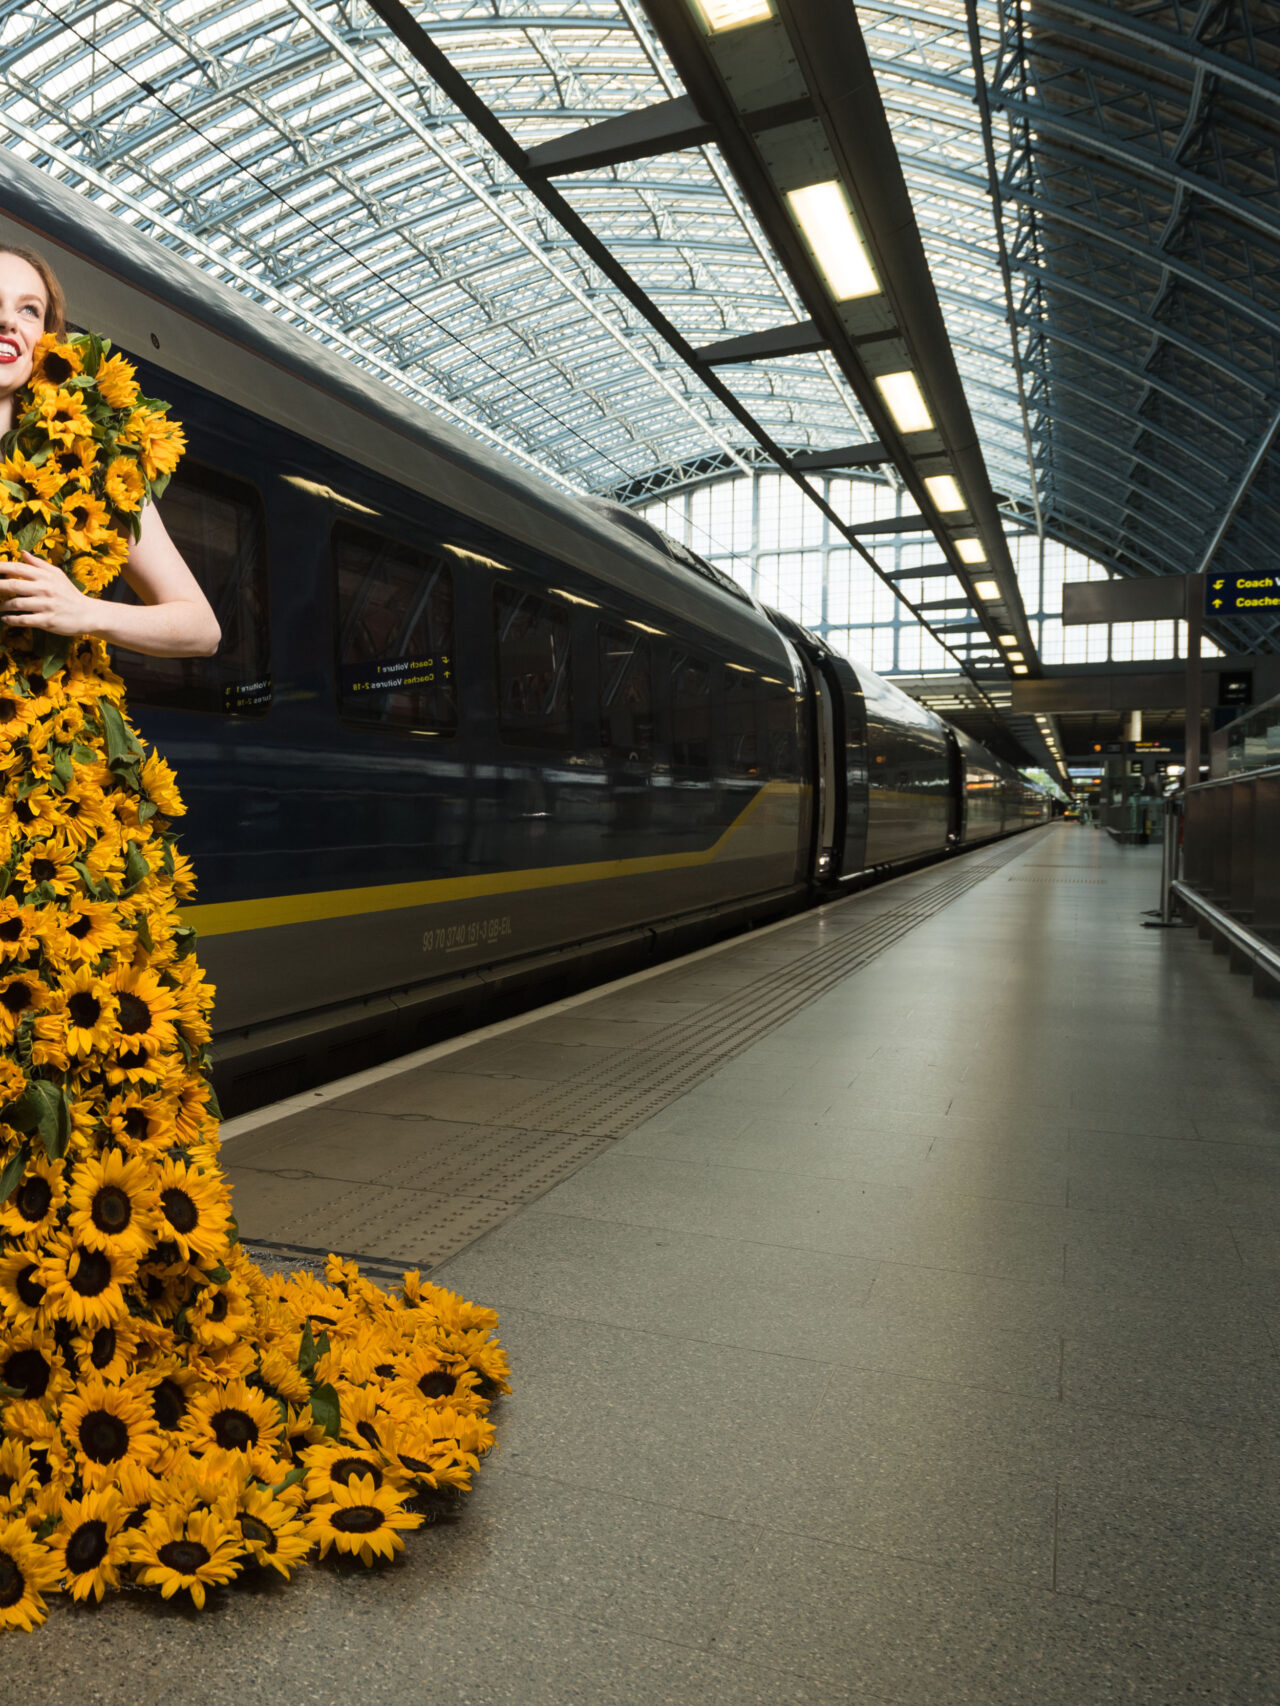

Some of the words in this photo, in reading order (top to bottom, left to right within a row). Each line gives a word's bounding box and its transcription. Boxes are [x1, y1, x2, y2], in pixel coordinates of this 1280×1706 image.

[1236, 577, 1274, 589] Coach
[422, 930, 434, 952] 93
[434, 928, 446, 950] 70
